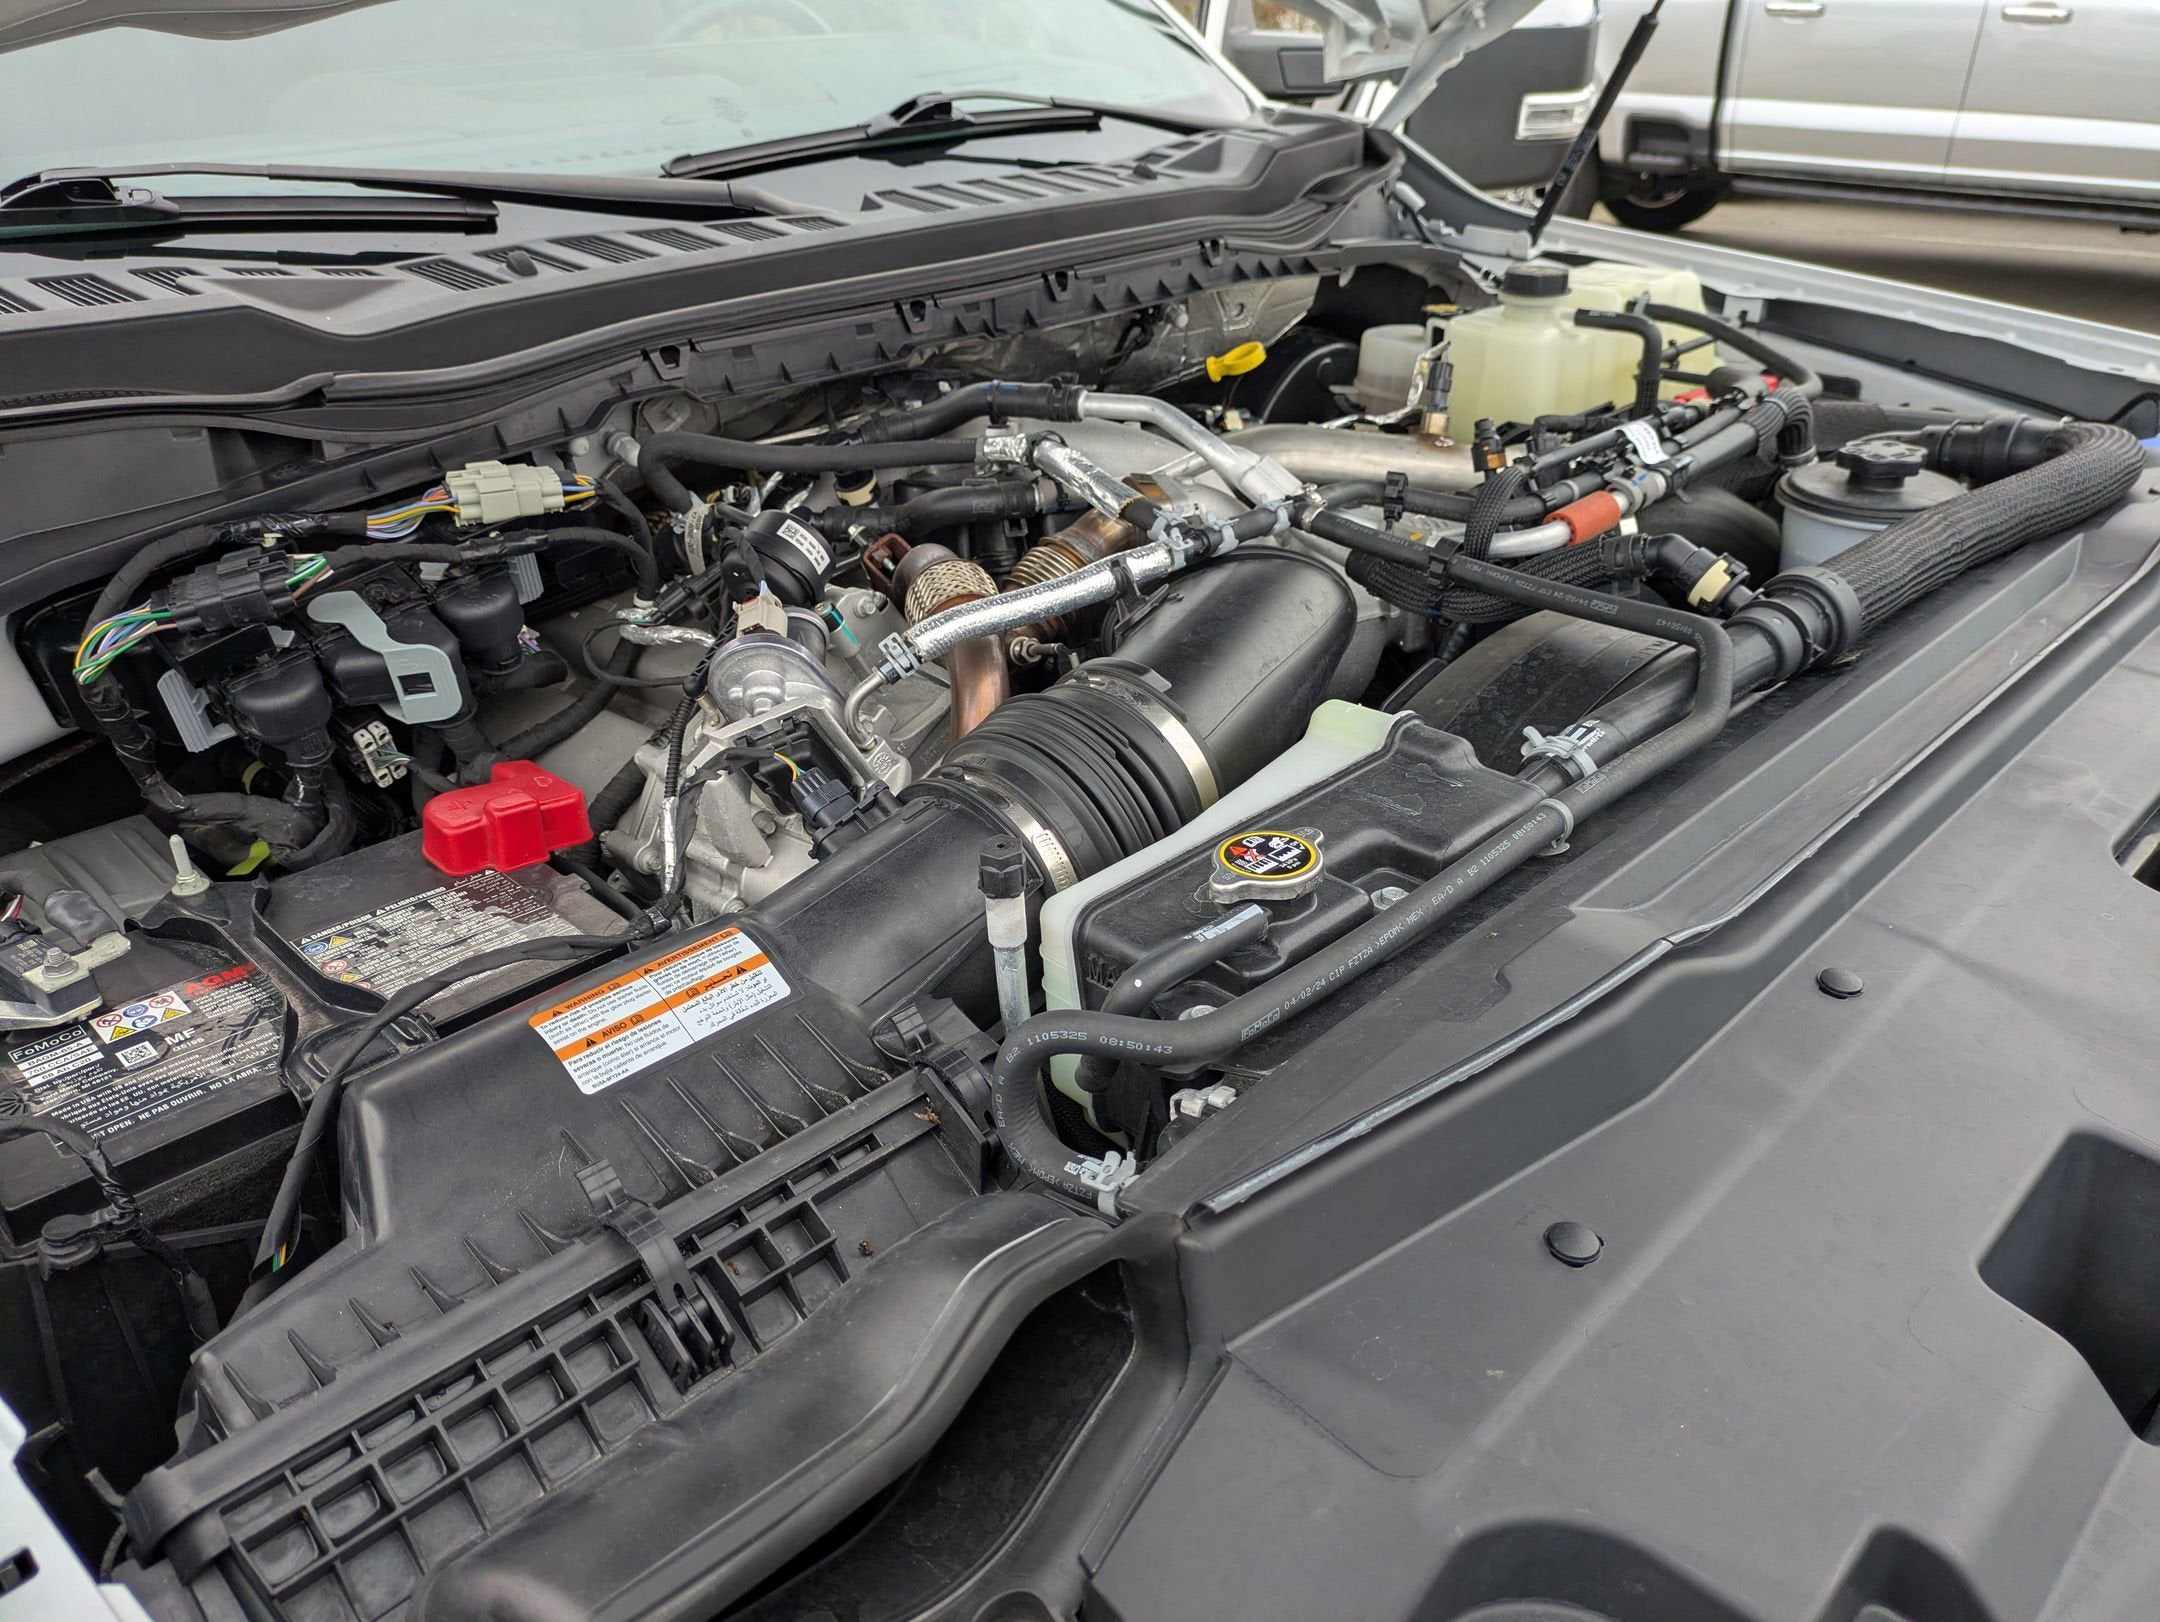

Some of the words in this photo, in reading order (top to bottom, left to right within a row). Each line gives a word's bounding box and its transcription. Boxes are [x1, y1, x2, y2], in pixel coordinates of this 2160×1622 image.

[1242, 1010, 1280, 1040] FoMoCo
[1284, 978, 1326, 1010] 04/02/24
[1329, 966, 1345, 982] CIP
[1406, 908, 1425, 925] MEX
[1431, 885, 1454, 906] EA/D
[1466, 865, 1479, 877] B2
[1479, 839, 1512, 866] 1105325
[1512, 812, 1547, 841] 08:50:43
[657, 937, 717, 966] AVERTISSEMENT
[1087, 953, 1118, 992] MA
[548, 1015, 568, 1025] reduce
[587, 995, 611, 1008] possible
[612, 985, 632, 996] serious
[564, 989, 604, 1009] WARNING
[164, 1027, 195, 1044] MF
[553, 1034, 569, 1044] assist
[583, 1047, 603, 1059] reducir
[610, 1034, 629, 1045] riesgo
[637, 1019, 661, 1032] lesiones
[602, 1022, 626, 1037] AVISO
[13, 1030, 81, 1059] FoMoCo
[27, 1041, 83, 1065] BAGM-65-A
[573, 1059, 595, 1072] severas
[643, 1027, 661, 1037] fluidos
[577, 1065, 602, 1079] arranque
[602, 1056, 620, 1066] (como
[639, 1036, 659, 1048] arranca
[26, 1065, 46, 1076] 750
[47, 1046, 94, 1067] CCA/SAE
[71, 1057, 91, 1068] C20
[613, 1057, 634, 1069] caliente
[995, 1095, 1006, 1128] EA/D
[1005, 1046, 1021, 1064] B2
[1027, 1030, 1088, 1046] 1105325
[1099, 1035, 1173, 1055] 08:50:43
[51, 1106, 71, 1116] Made
[107, 1119, 134, 1133] OPEN.
[151, 1103, 169, 1114] PAS
[170, 1089, 205, 1106] OUVRIR.
[236, 1066, 261, 1079] ABRA.
